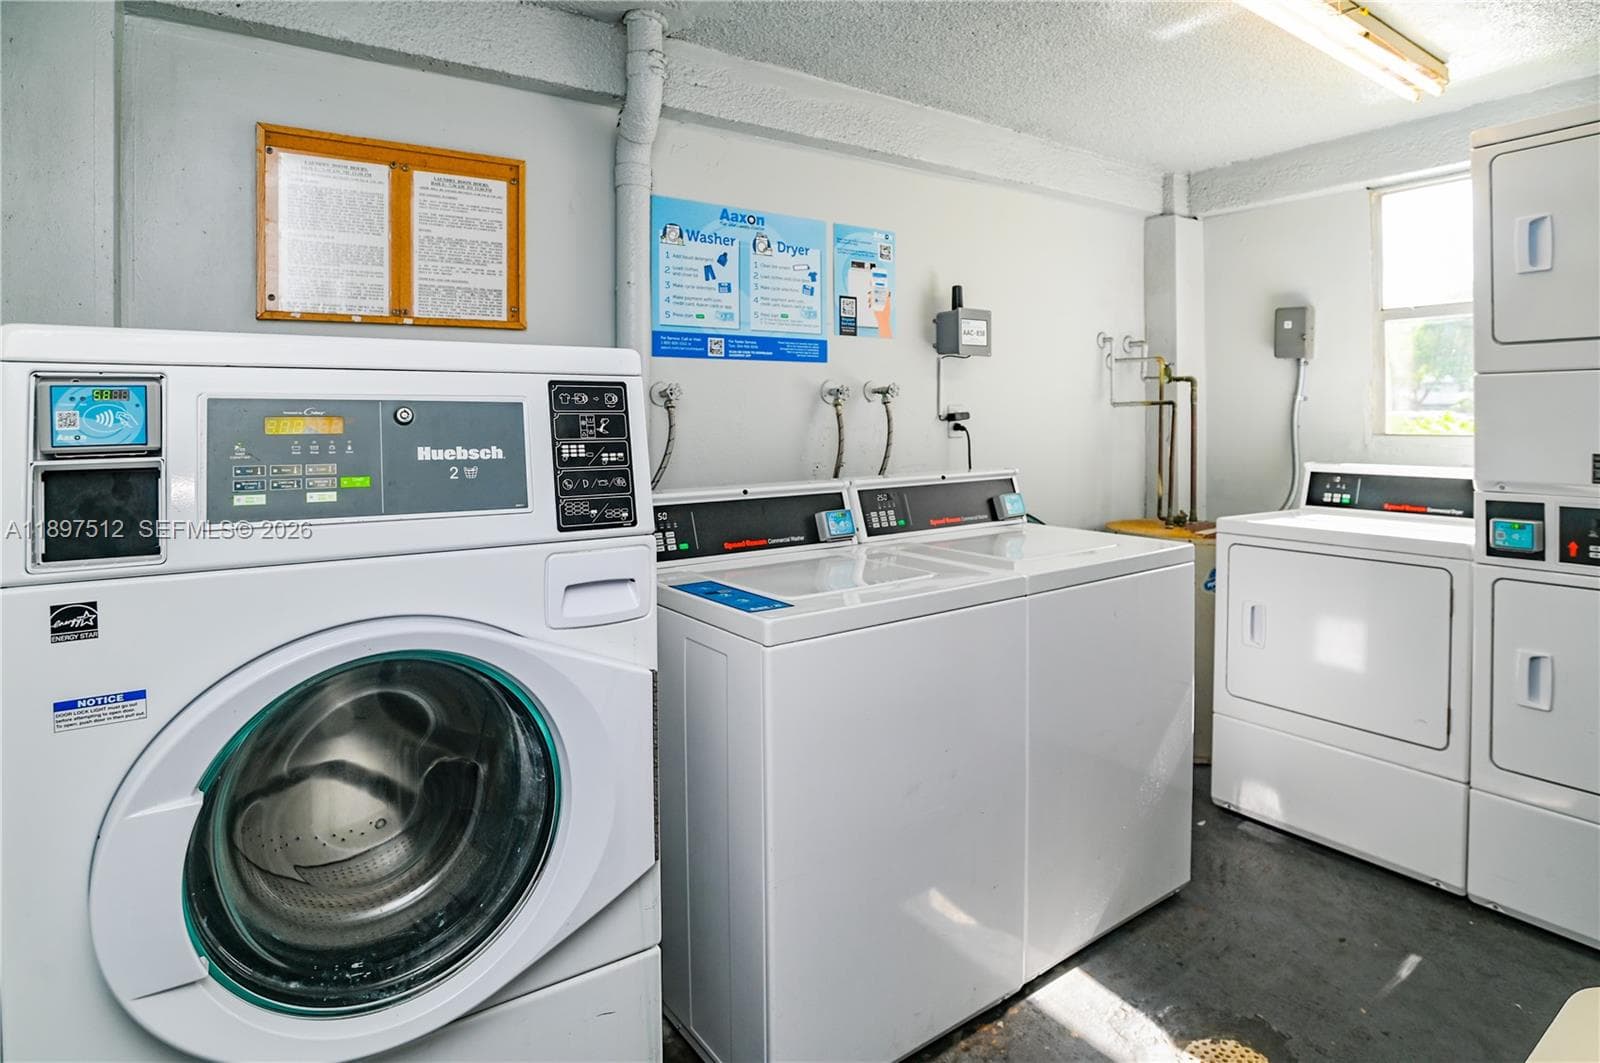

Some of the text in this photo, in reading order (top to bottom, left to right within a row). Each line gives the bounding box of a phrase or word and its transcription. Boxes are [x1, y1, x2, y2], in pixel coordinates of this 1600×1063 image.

[720, 208, 765, 226] Aaxon
[686, 229, 736, 247] Washer
[666, 251, 670, 259] 1
[777, 241, 810, 257] Dryer
[753, 272, 759, 280] 2
[665, 281, 670, 289] 3
[417, 446, 503, 460] Huebsch
[449, 466, 459, 479] 2
[51, 631, 98, 643] ENERGY STAR
[77, 694, 124, 707] NOTICE
[74, 713, 101, 721] attempting
